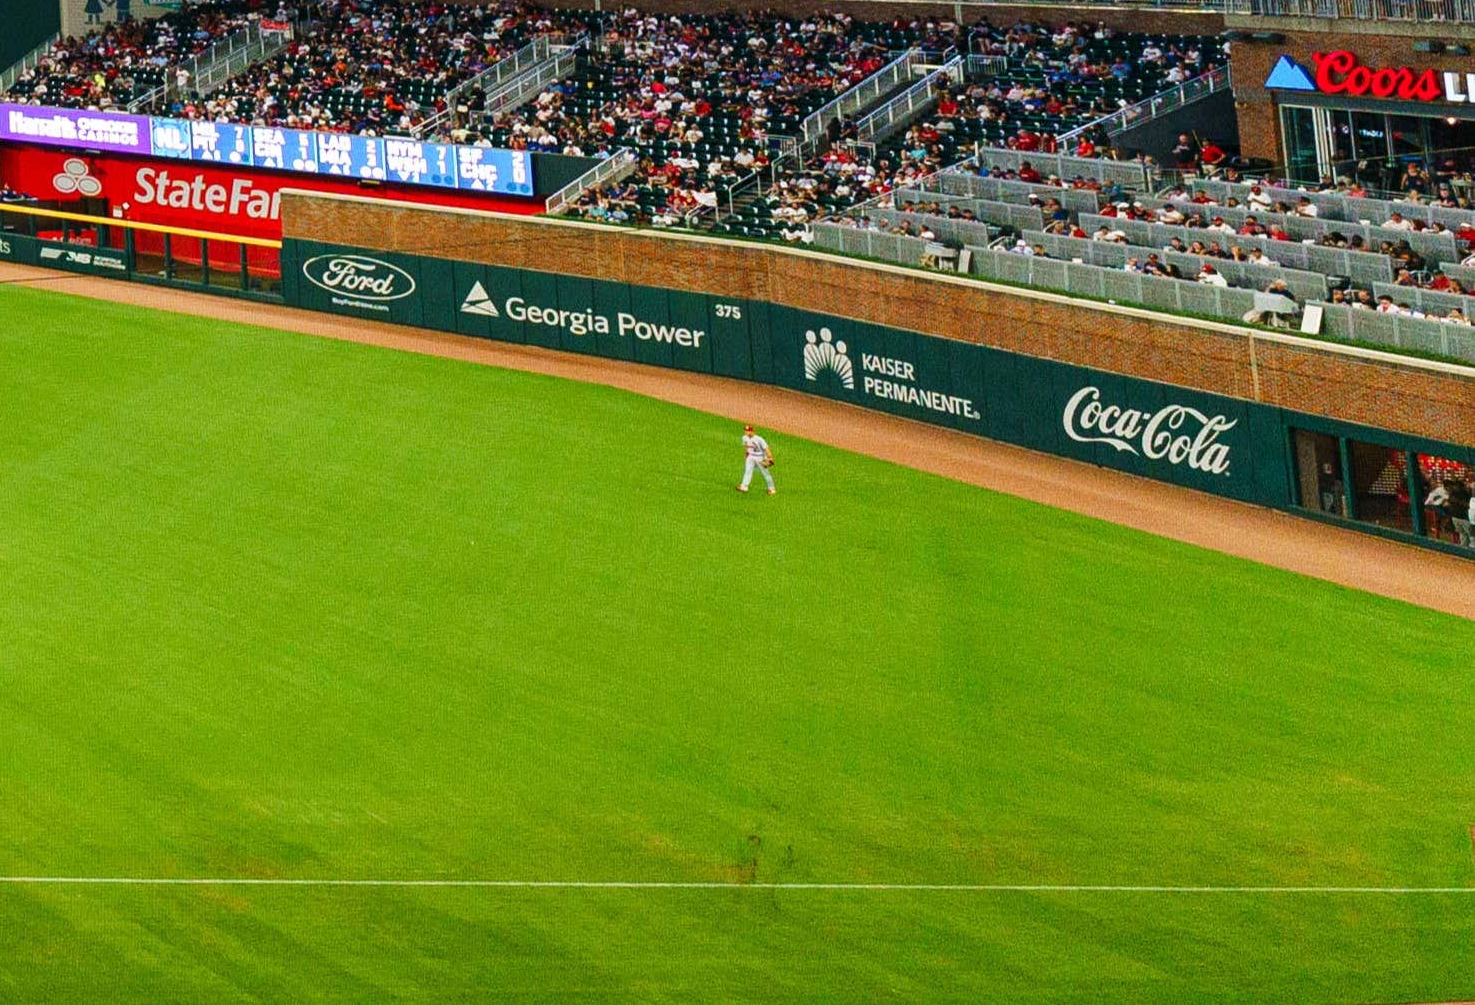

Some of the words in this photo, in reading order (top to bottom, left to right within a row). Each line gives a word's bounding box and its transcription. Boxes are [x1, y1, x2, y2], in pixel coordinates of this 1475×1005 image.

[1312, 50, 1442, 101] Coors
[78, 129, 139, 146] CASINOS
[155, 128, 182, 147] NL
[133, 167, 225, 214] State
[322, 255, 394, 296] Ford
[505, 296, 610, 336] Georgia
[617, 311, 705, 348] Power
[715, 303, 742, 320] 375
[862, 352, 915, 382] KAISER
[864, 376, 976, 420] PERMANENTE
[1064, 385, 1238, 476] Coca-Cola
